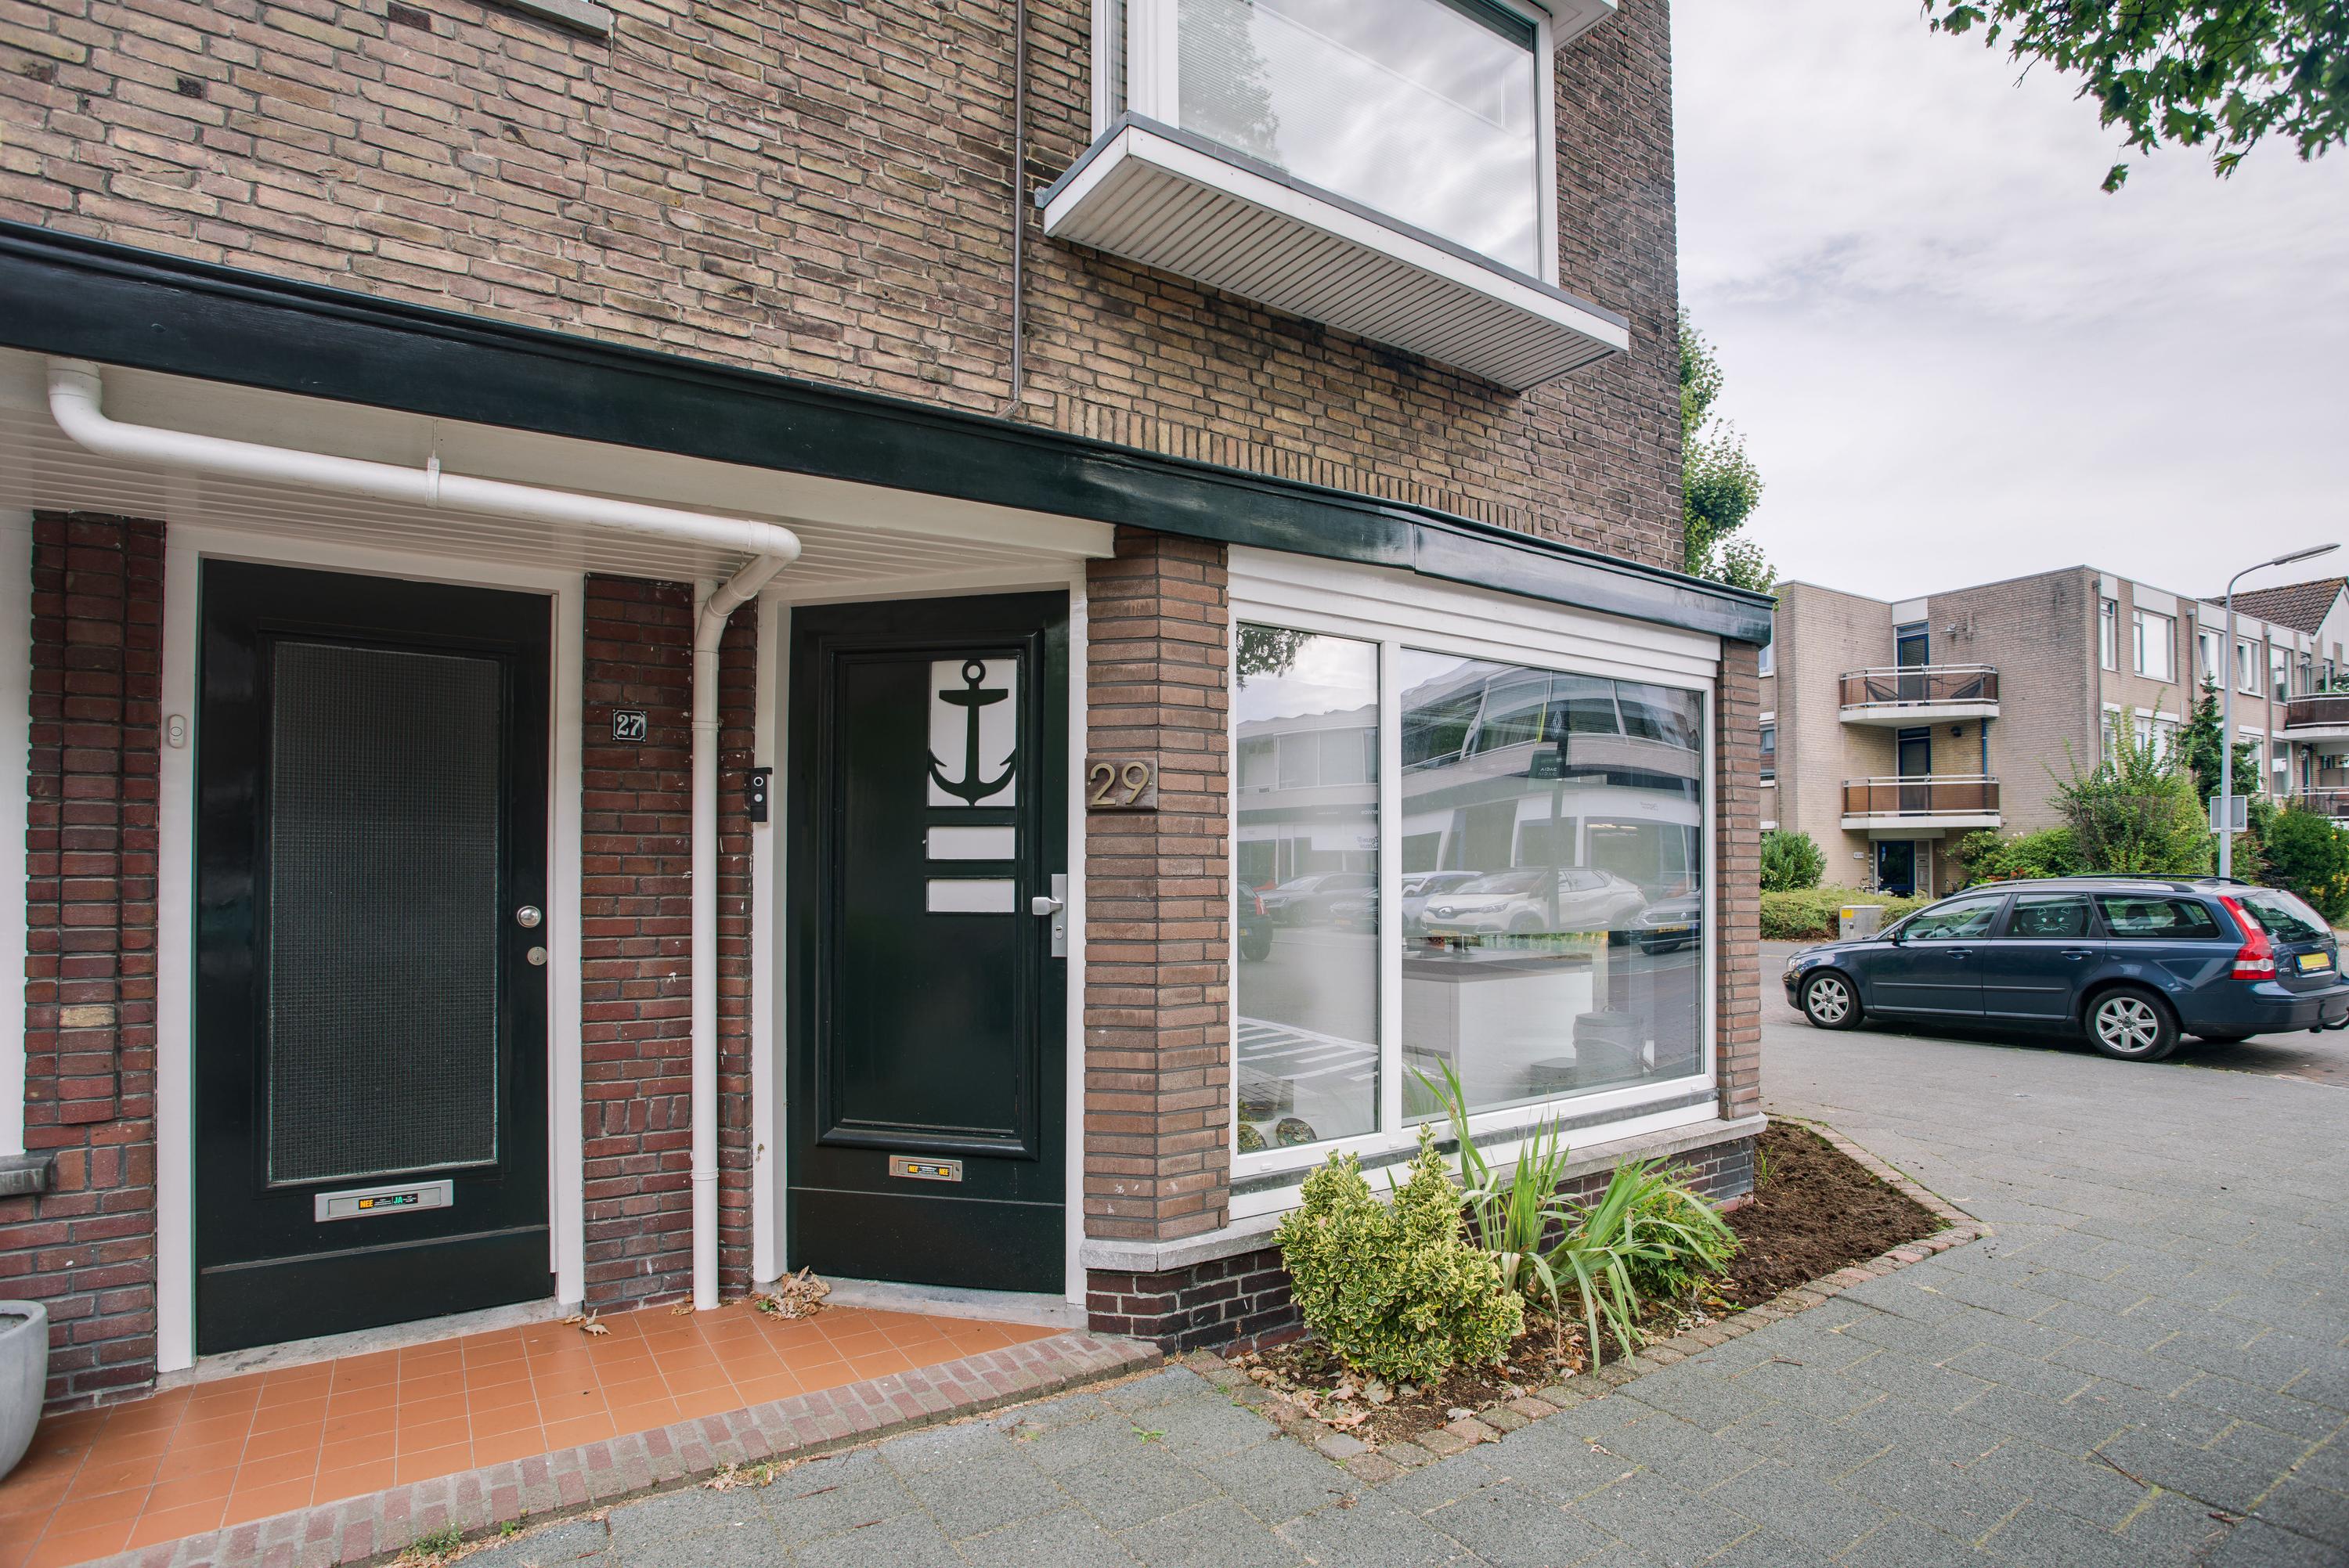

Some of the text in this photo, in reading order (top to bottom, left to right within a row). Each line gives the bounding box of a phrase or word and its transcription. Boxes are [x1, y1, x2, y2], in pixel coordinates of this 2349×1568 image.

[617, 714, 641, 736] 27
[1090, 761, 1149, 806] 29
[359, 1199, 373, 1208] NEE
